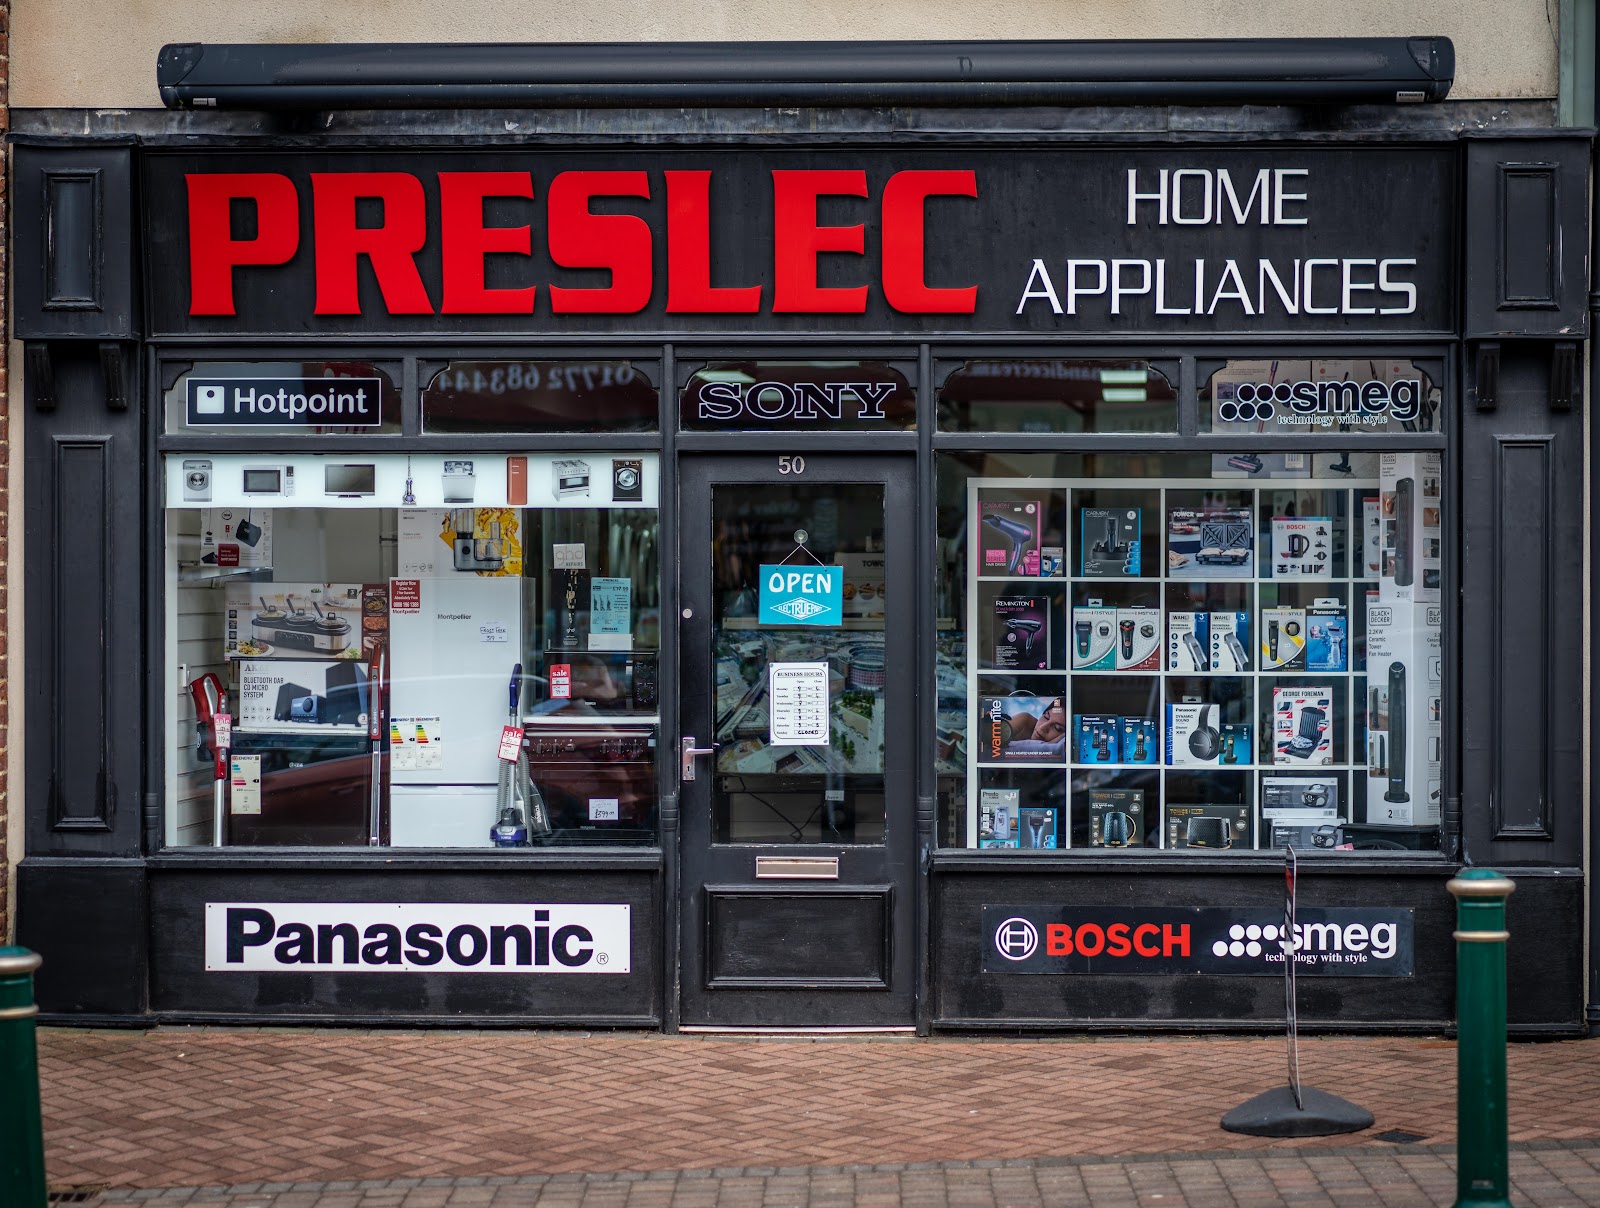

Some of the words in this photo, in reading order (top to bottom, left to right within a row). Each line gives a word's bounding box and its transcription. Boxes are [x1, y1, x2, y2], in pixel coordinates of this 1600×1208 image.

[1127, 168, 1309, 225] HOME
[184, 169, 979, 315] PRESLEC
[1016, 258, 1417, 315] APPLIANCES
[234, 387, 368, 420] Hotpoint
[699, 382, 896, 419] SONY
[1290, 379, 1421, 421] smeg
[1277, 414, 1335, 427] technology
[1336, 414, 1361, 425] with
[1362, 414, 1388, 426] style
[777, 456, 805, 474] 50
[555, 545, 584, 566] ghd
[768, 573, 832, 594] OPEN
[437, 613, 472, 621] Montpellier
[243, 676, 273, 684] BLUETOOTH
[243, 691, 264, 699] SYSTEM
[504, 730, 522, 738] sale
[1388, 809, 1393, 819] 2
[226, 907, 594, 967] Panasonic
[1046, 923, 1191, 958] BOSCH
[1279, 923, 1397, 959] smeg
[1264, 952, 1318, 964] techology
[1320, 952, 1343, 962] with
[1345, 952, 1368, 964] style
